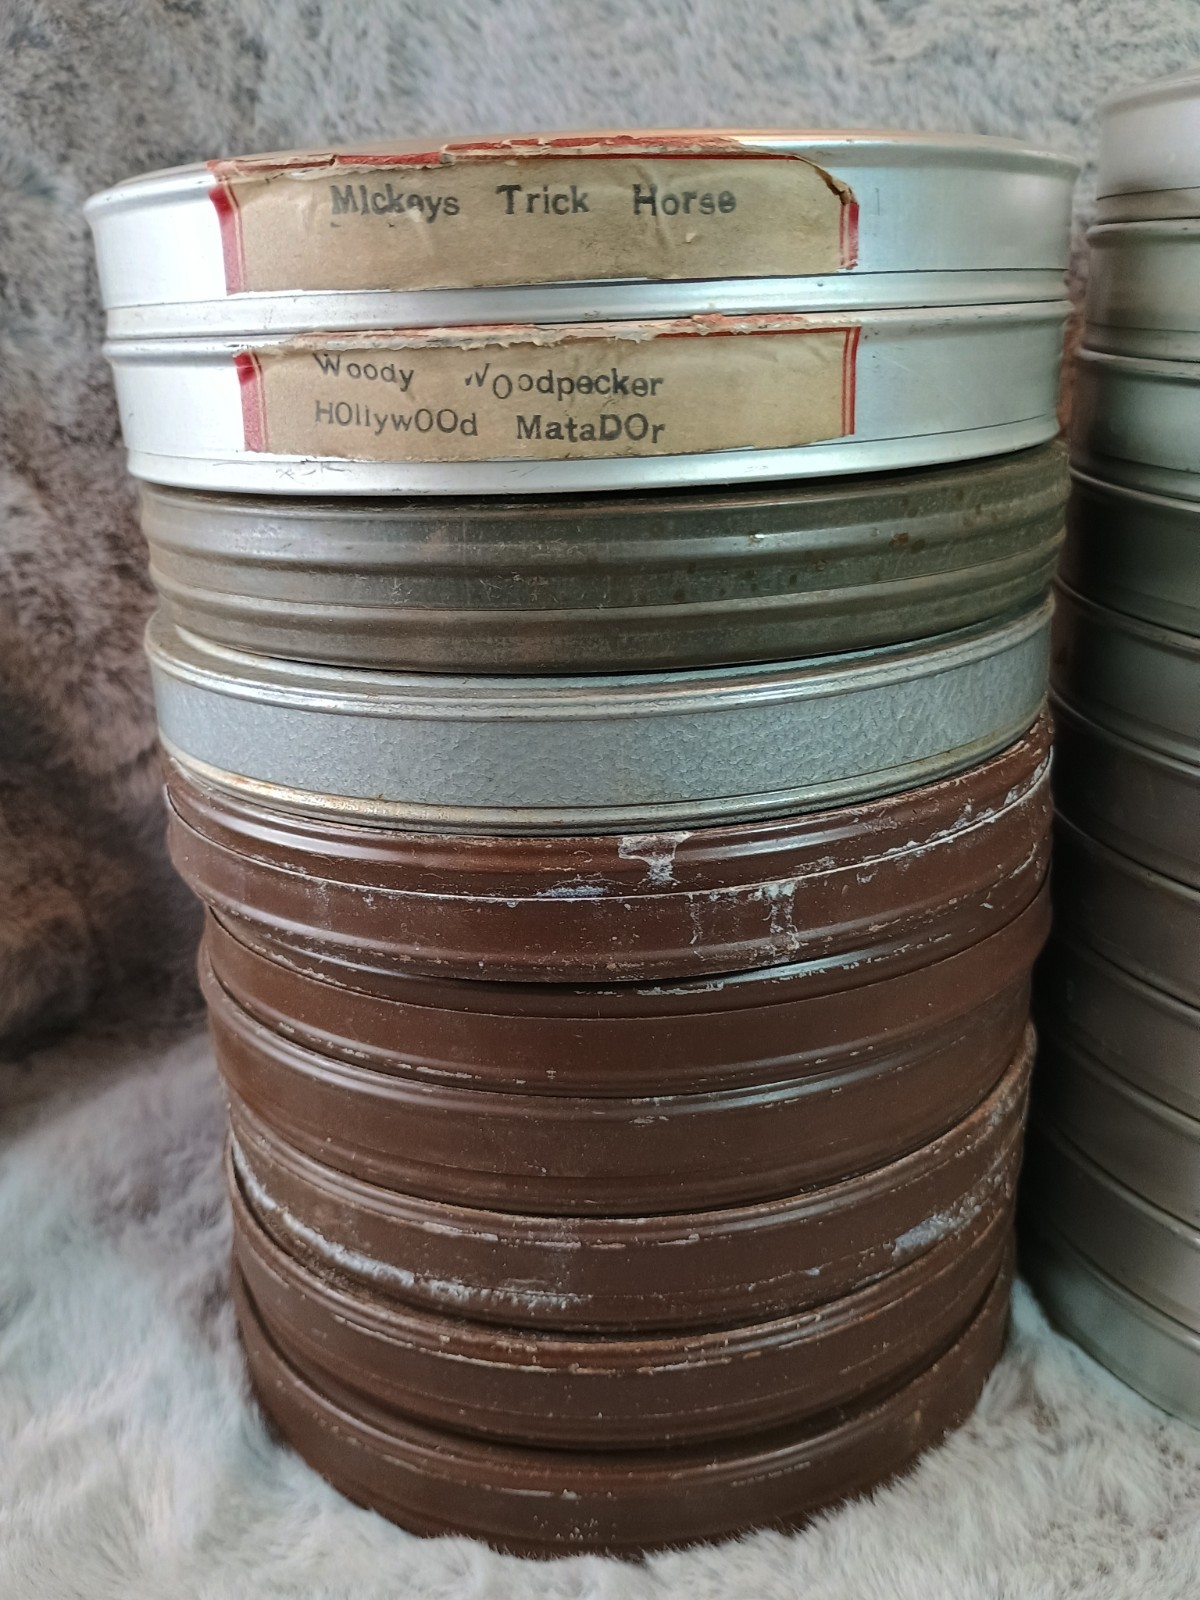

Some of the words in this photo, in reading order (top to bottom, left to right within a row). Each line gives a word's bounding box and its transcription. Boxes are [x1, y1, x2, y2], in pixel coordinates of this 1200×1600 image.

[495, 184, 590, 215] Trick
[632, 183, 737, 217] Horse
[312, 353, 414, 392] Woody
